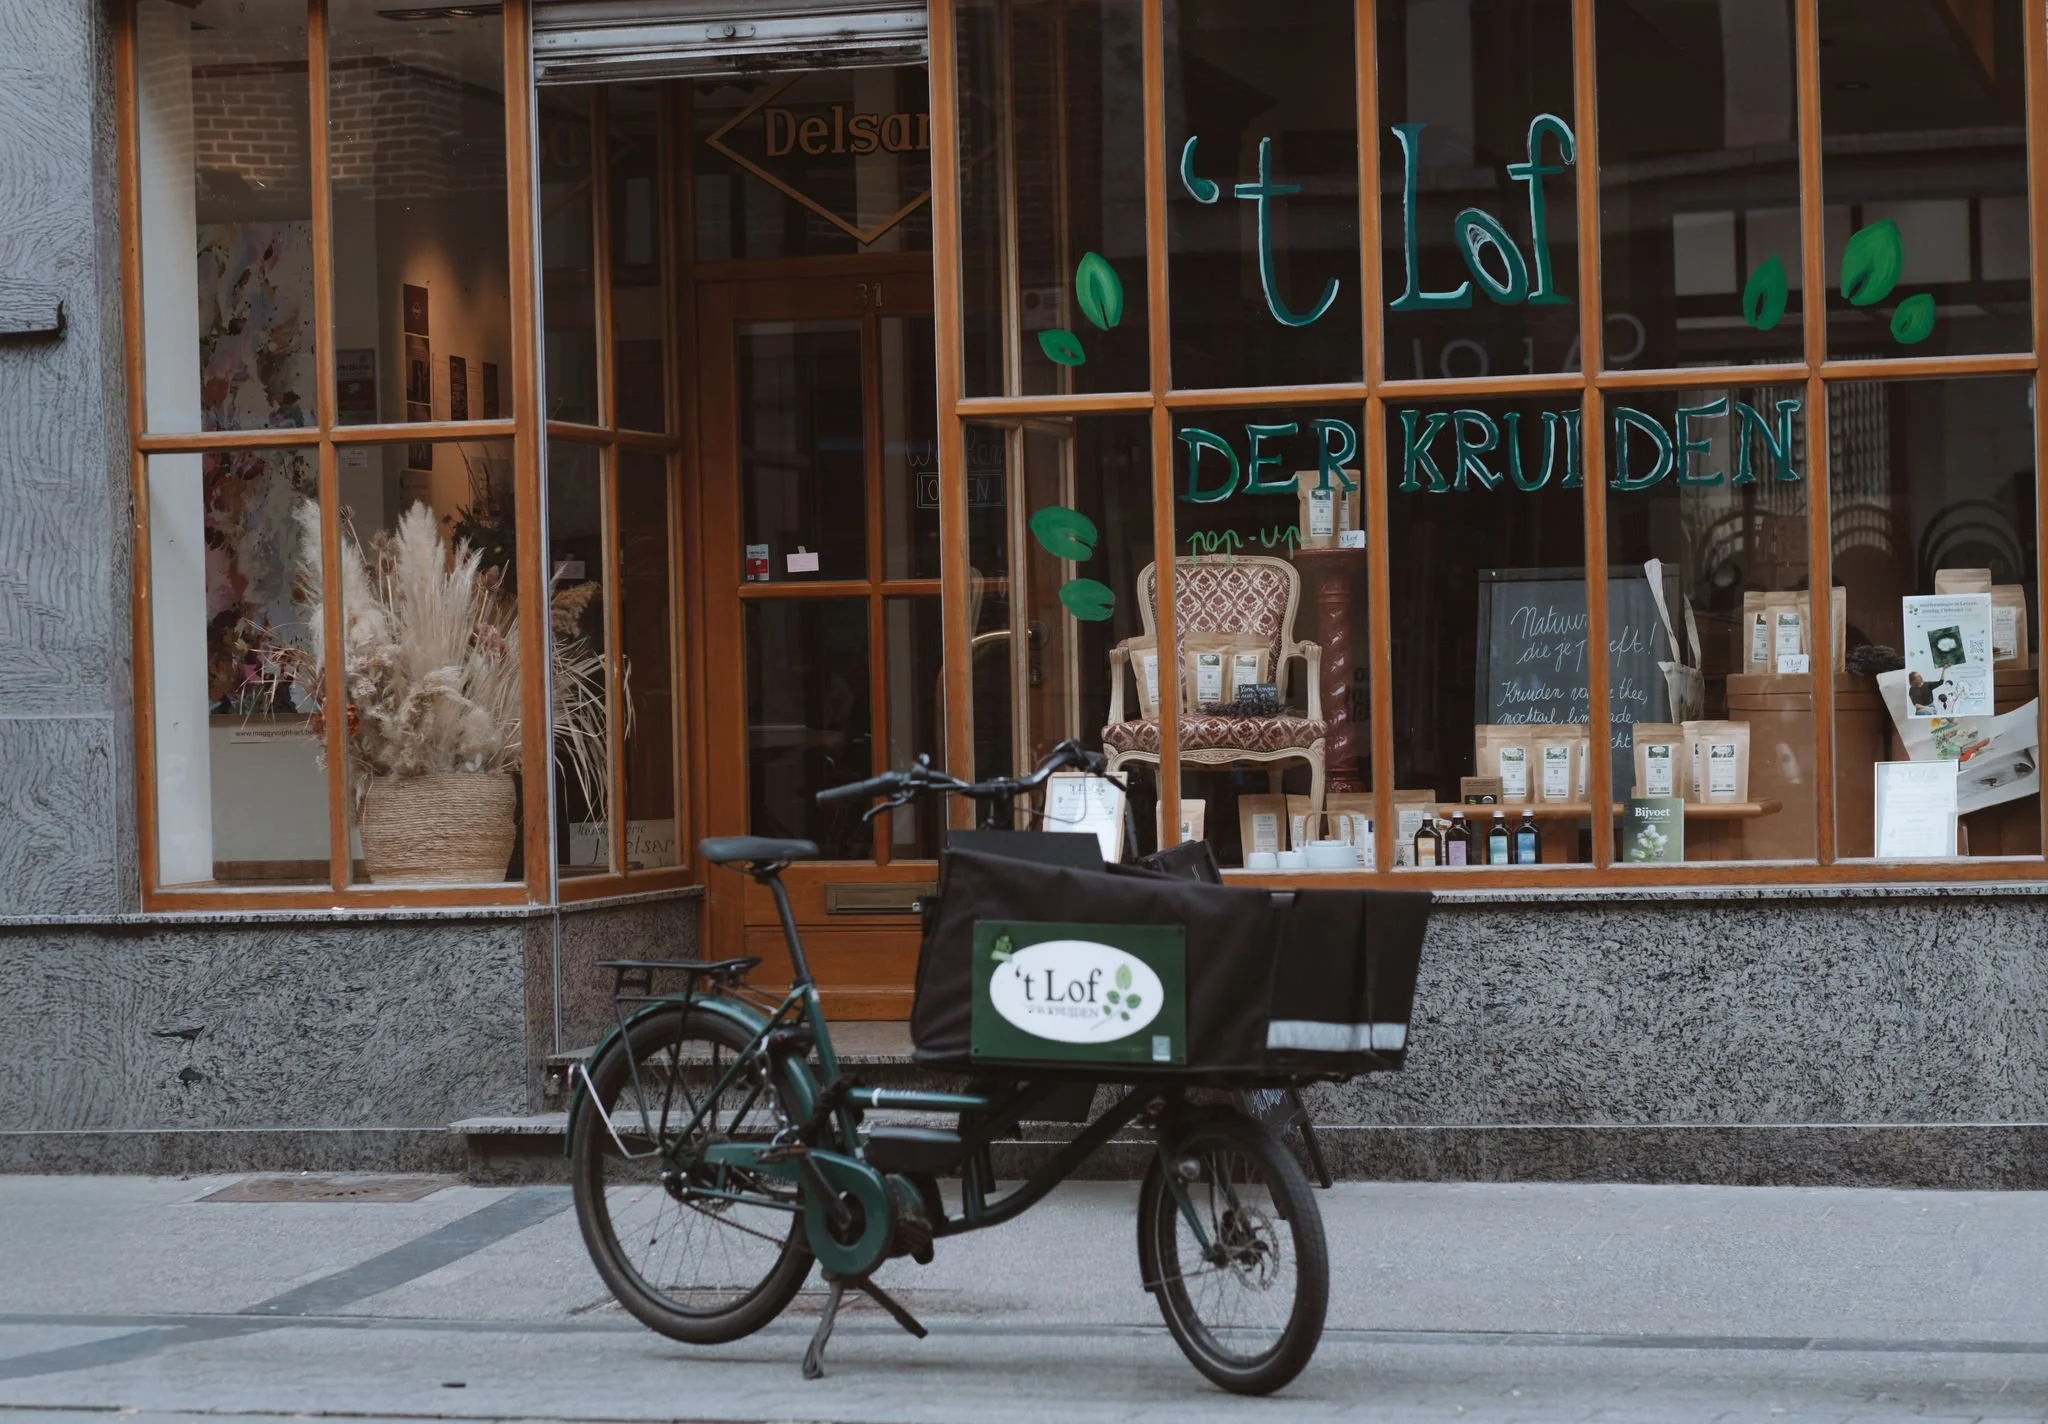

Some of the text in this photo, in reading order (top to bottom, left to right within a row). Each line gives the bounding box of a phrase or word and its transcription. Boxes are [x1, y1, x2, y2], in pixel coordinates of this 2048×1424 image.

[1389, 113, 1576, 311] Lof
[856, 282, 884, 308] 31
[1177, 397, 1801, 504] DER KRUIDEN
[1186, 525, 1308, 567] pop-up
[1516, 640, 1552, 665] die
[1554, 639, 1572, 673] je
[1496, 680, 1565, 707] Kruiden
[1635, 807, 1671, 819] Bijvoet
[1015, 965, 1102, 1004] 't Lof
